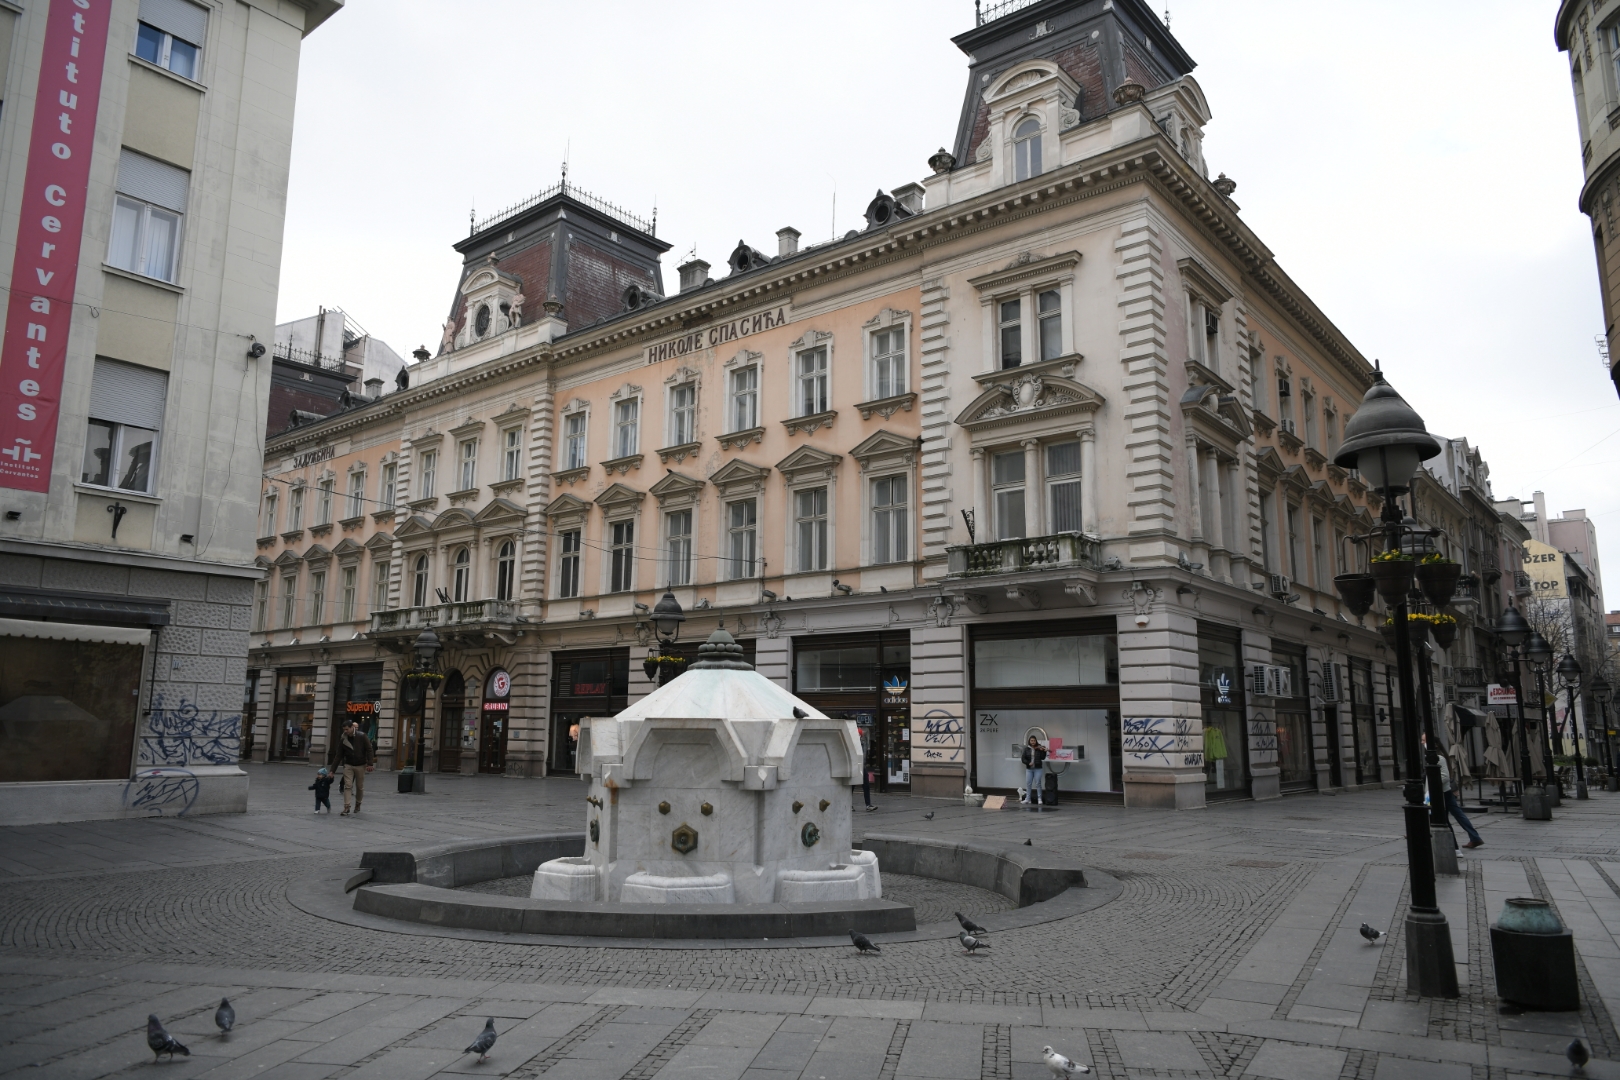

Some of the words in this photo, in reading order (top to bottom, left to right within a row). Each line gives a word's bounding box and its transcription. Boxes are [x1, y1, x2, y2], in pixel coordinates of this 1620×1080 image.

[17, 184, 66, 421] Cervantes
[649, 333, 703, 363] НИКОЛЕ
[709, 308, 785, 345] СПАСИЋА
[293, 445, 335, 469] ЗАДУЖБИНА
[0, 461, 40, 472] Instituto
[0, 468, 39, 479] Cervantes
[574, 683, 606, 694] REPLAY
[884, 696, 908, 704] adidas
